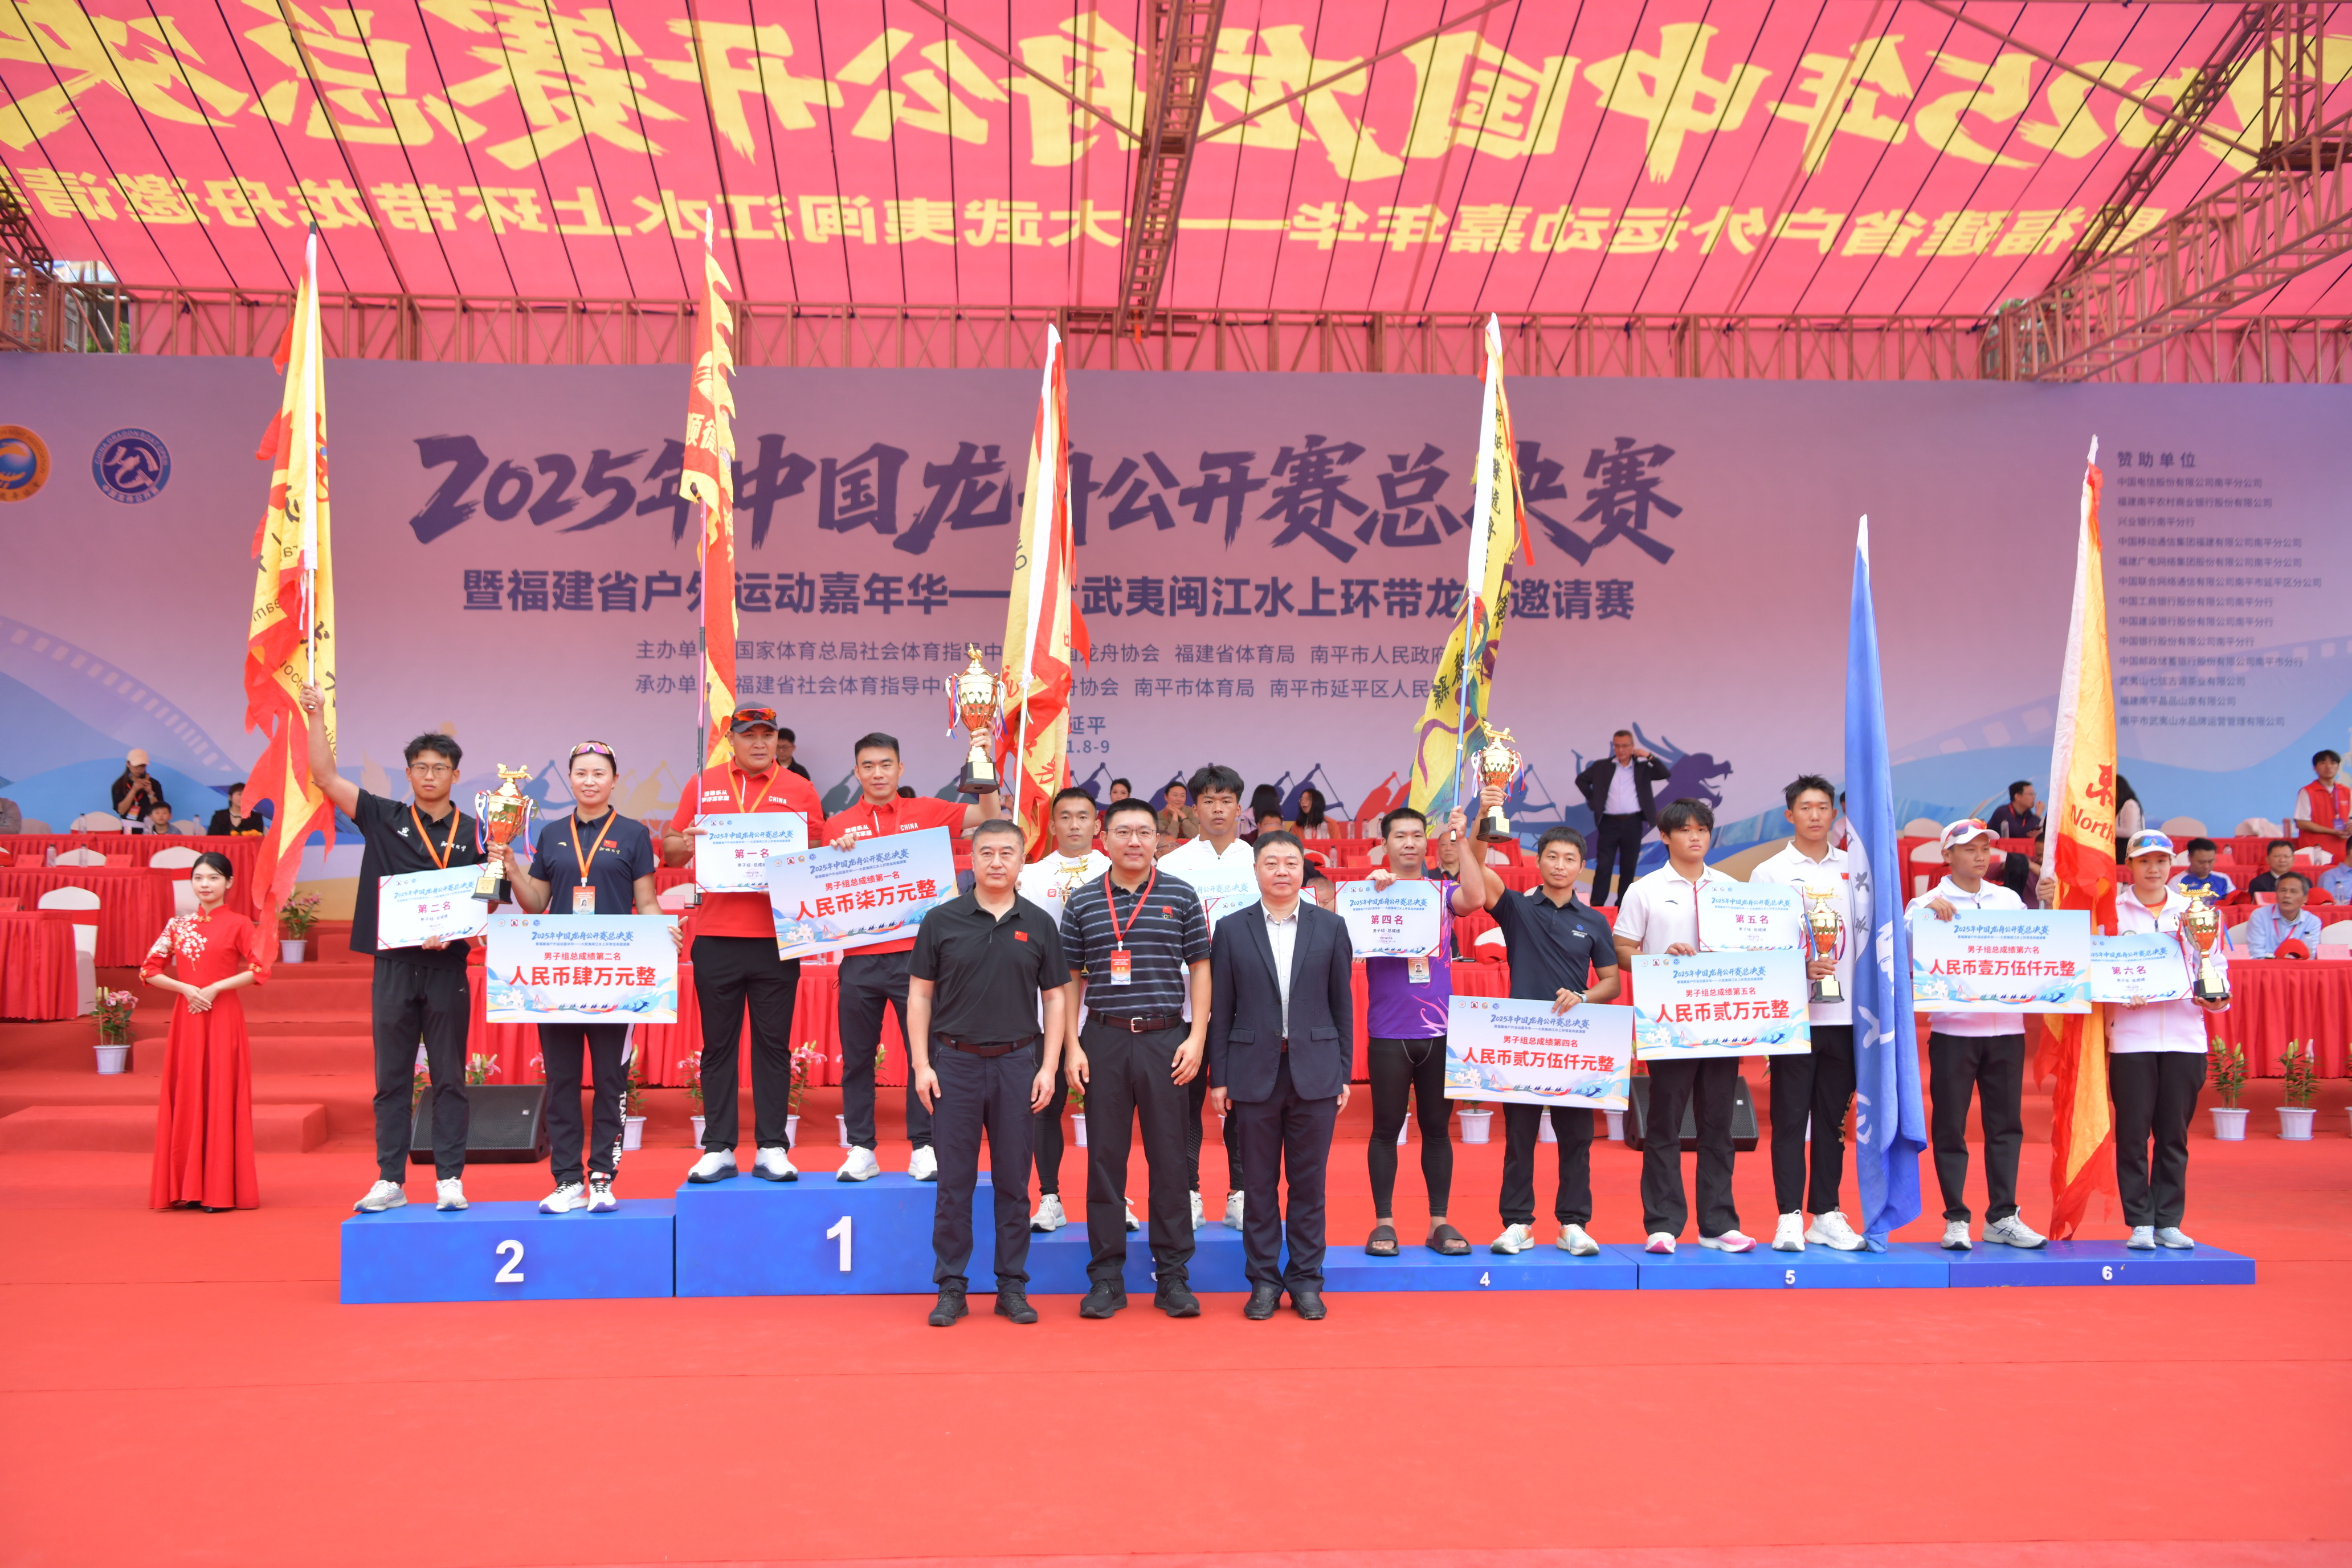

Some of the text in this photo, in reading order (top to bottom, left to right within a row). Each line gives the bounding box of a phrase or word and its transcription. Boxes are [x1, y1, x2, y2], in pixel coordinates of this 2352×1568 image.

[2117, 451, 2196, 468] 赞助单位
[2117, 516, 2196, 528] 兴业银行南平分行
[1174, 643, 1296, 664] 福建省体育局
[1134, 677, 1255, 699] 南平市体育局
[1269, 678, 1430, 700] 南平市延平区人民
[769, 795, 787, 805] CHINA
[900, 822, 918, 831] CHINA
[709, 830, 794, 840] 2025年中国龙舟公开赛总决赛
[734, 848, 769, 859] 第一名
[809, 848, 910, 875] 2025年中国龙舟公开赛总决赛
[825, 871, 900, 892] 男子组总成绩第一名
[393, 881, 475, 899] 2025年中国龙舟公开赛总决赛
[1194, 883, 1249, 894] 舟公开赛总决赛
[795, 879, 938, 922] 人民币柒万元整
[1349, 897, 1428, 907] 2025年中国龙舟公开赛总决赛
[1711, 897, 1791, 908] 2025年中国龙舟公开赛总决赛
[418, 901, 451, 914] 第二名
[1371, 914, 1403, 925] 第四名
[1736, 914, 1769, 924] 第五名
[531, 930, 634, 942] 2025年中国龙舟公开赛总决赛
[1954, 925, 2050, 935] 2025年中国龙舟公开赛总决赛
[1967, 945, 2040, 954] 男子组总成绩第六名
[544, 952, 621, 961] 男子组总成绩第二名
[1673, 966, 1766, 979] 2025年中国龙舟公开赛总决赛
[1929, 958, 2076, 977] 人民币壹万伍仟元整
[2112, 965, 2146, 975] 第六名
[509, 966, 656, 987] 人民币肆万元整
[1686, 987, 1756, 997] 男子组总成绩第五名
[1655, 999, 1790, 1024] 人民币贰万元整
[1490, 1014, 1590, 1030] 2025年中国龙舟公开赛总决赛
[1503, 1035, 1578, 1048] 男子组总成绩第四名
[1463, 1047, 1615, 1073] 人民币贰万伍仟元整
[826, 1216, 852, 1271] 1
[495, 1239, 524, 1283] 2
[1786, 1270, 1796, 1284] 5
[2101, 1265, 2113, 1280] 6
[1479, 1272, 1490, 1287] 4
